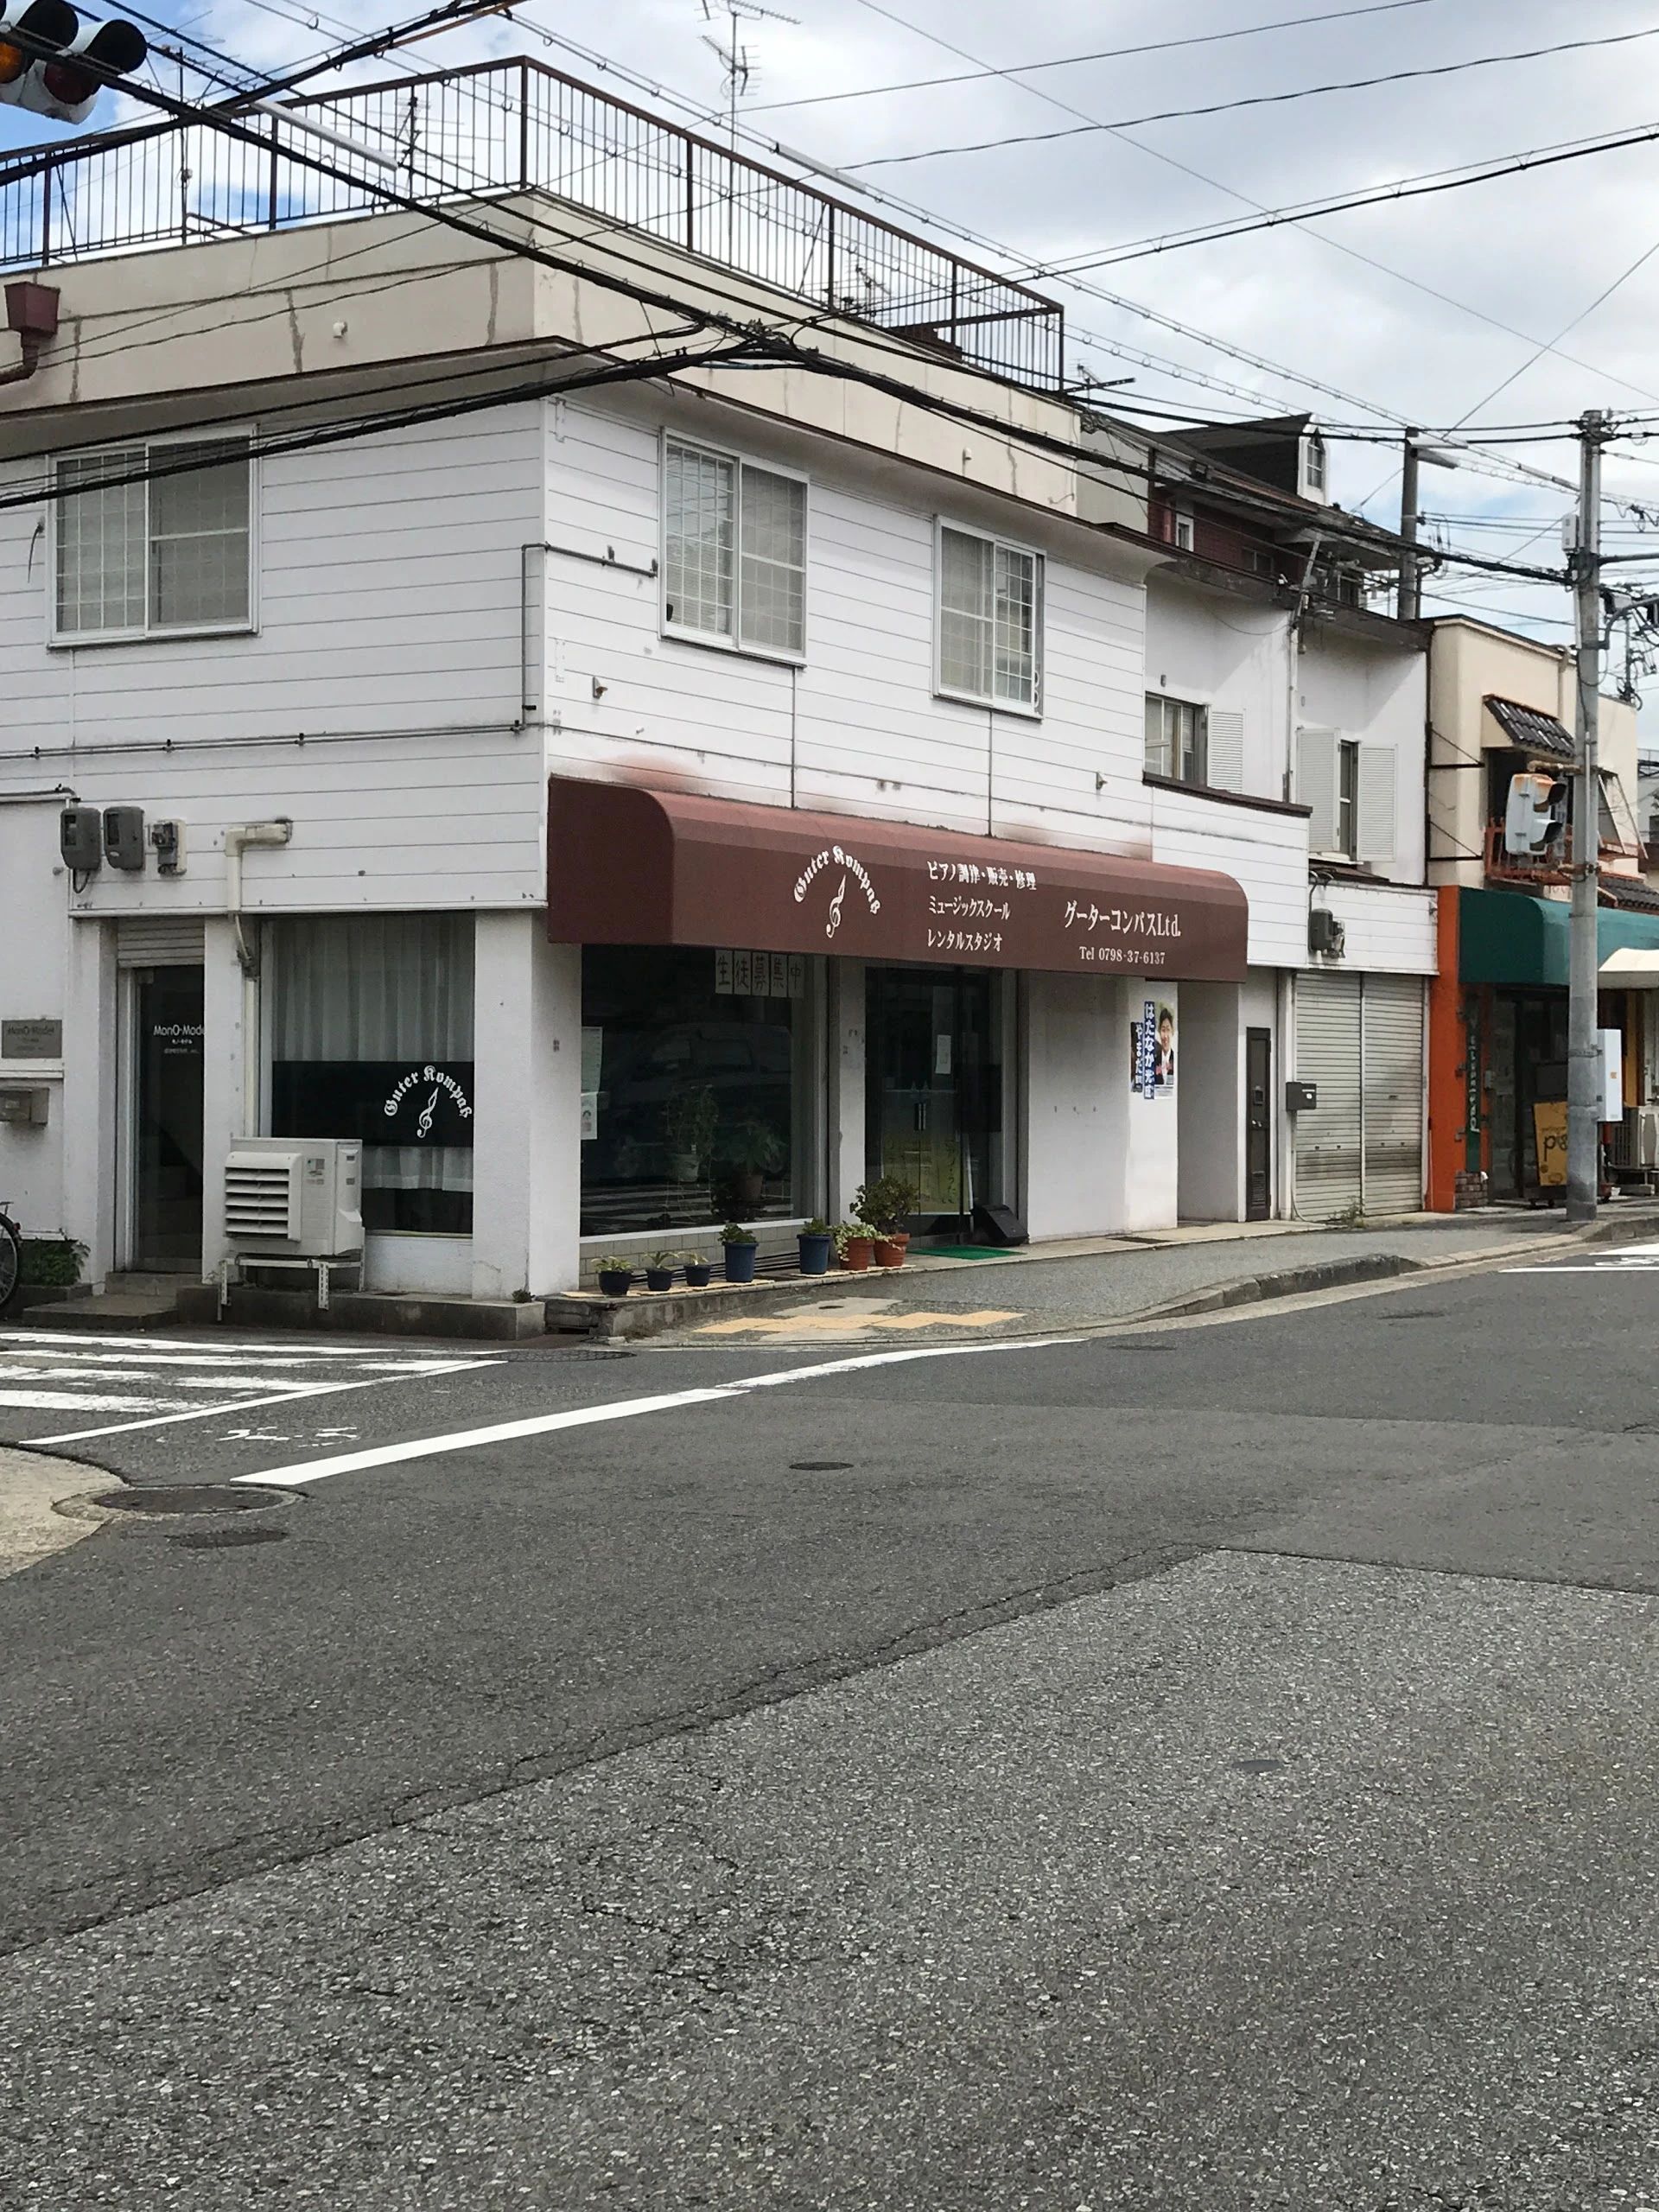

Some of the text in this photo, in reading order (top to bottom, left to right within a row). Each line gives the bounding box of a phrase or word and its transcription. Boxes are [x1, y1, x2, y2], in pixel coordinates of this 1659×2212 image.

[793, 851, 830, 903] Guter
[929, 895, 1010, 920] ミュージックスクール
[927, 929, 1002, 951] レンタルスタジオ
[1079, 946, 1166, 964] Tel 0798-37-6137
[717, 955, 802, 990] 生徒募集中
[384, 1071, 419, 1116] Guter
